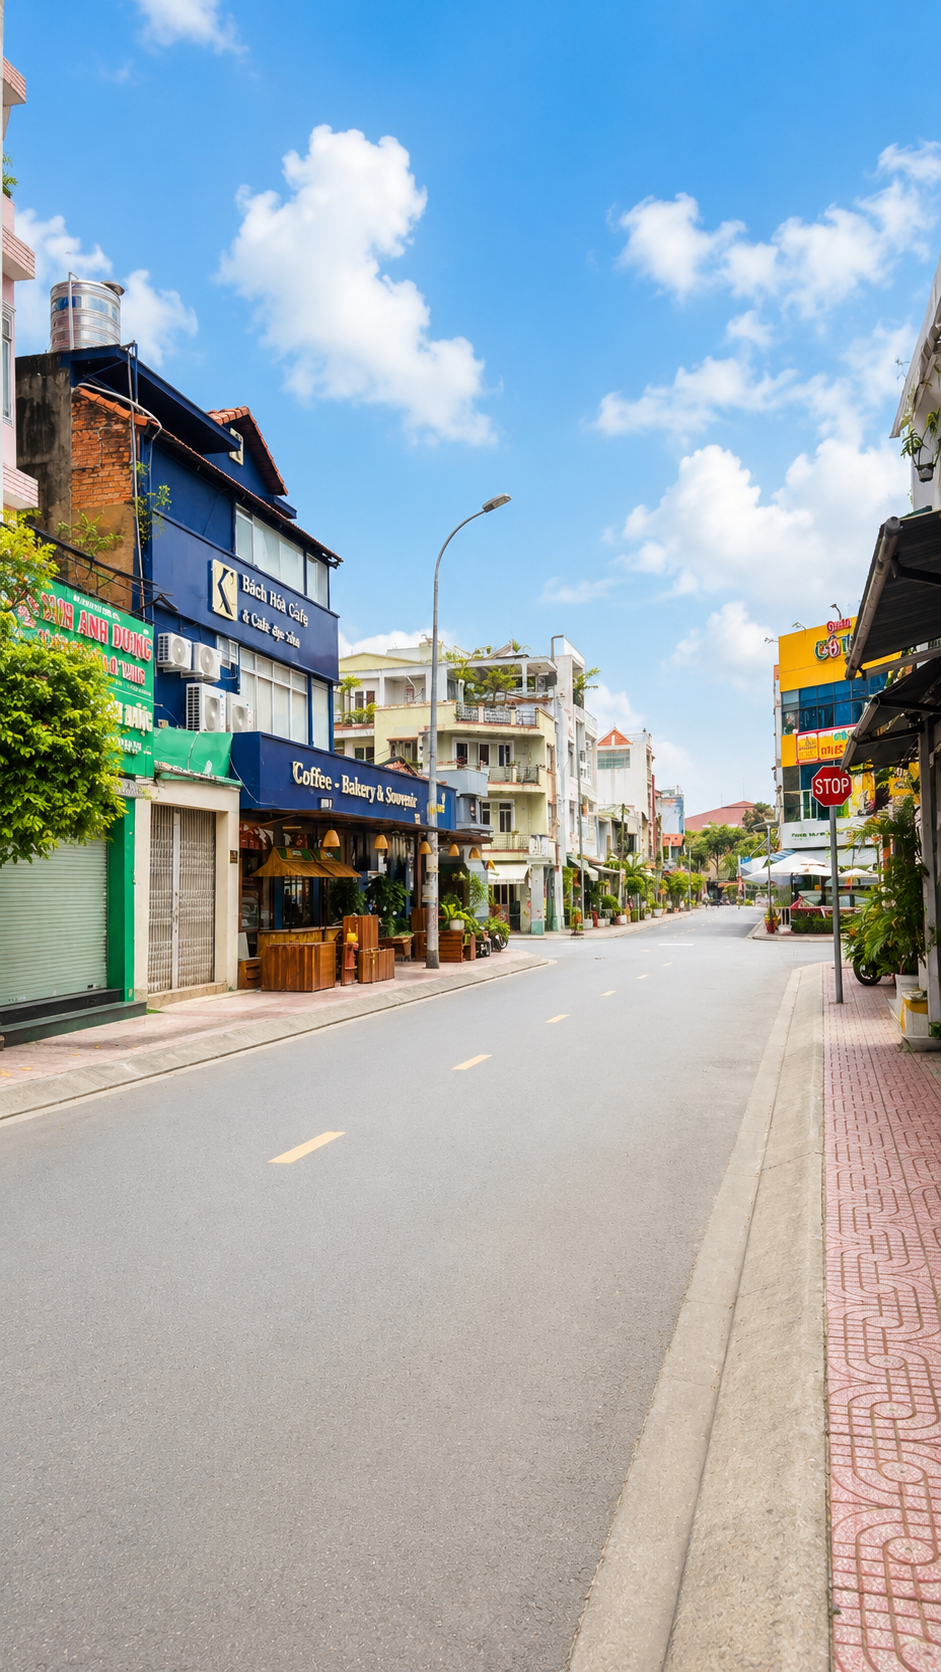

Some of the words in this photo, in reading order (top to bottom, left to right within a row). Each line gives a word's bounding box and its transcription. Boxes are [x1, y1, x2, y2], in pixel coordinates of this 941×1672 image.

[242, 574, 268, 603] Bách
[269, 590, 287, 614] Hóa
[76, 609, 109, 645] ANH
[292, 761, 332, 791] Coffee
[341, 774, 376, 804] Bakery
[376, 784, 384, 803] &
[385, 786, 418, 810] Souvenir
[815, 777, 849, 795] STOP
